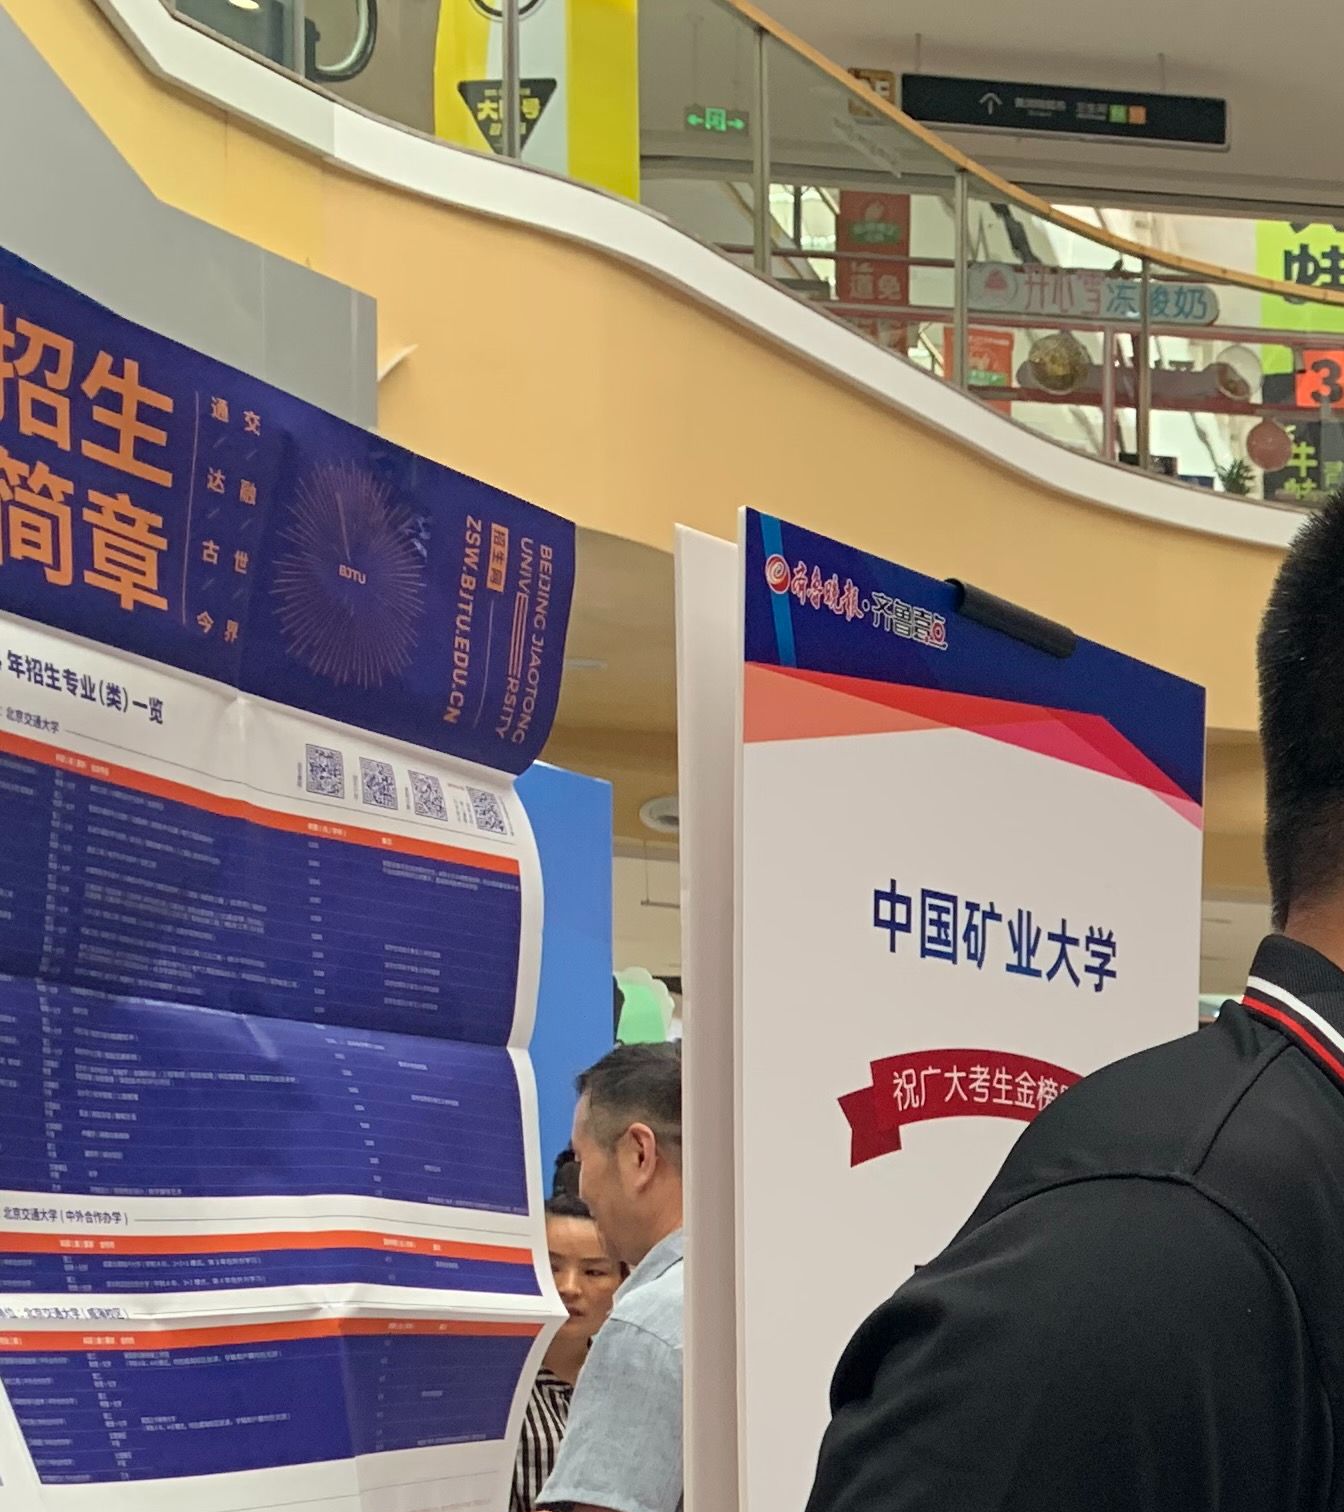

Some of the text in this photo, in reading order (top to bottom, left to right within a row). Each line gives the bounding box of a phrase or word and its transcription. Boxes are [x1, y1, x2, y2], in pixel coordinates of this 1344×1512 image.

[442, 514, 483, 726] ZSW.BJTU.EDU.CN
[510, 543, 554, 745] BEIJING JIAOTONG
[871, 878, 1118, 993] 中国矿业大学
[892, 1063, 1068, 1112] 祝广大考生金榜
